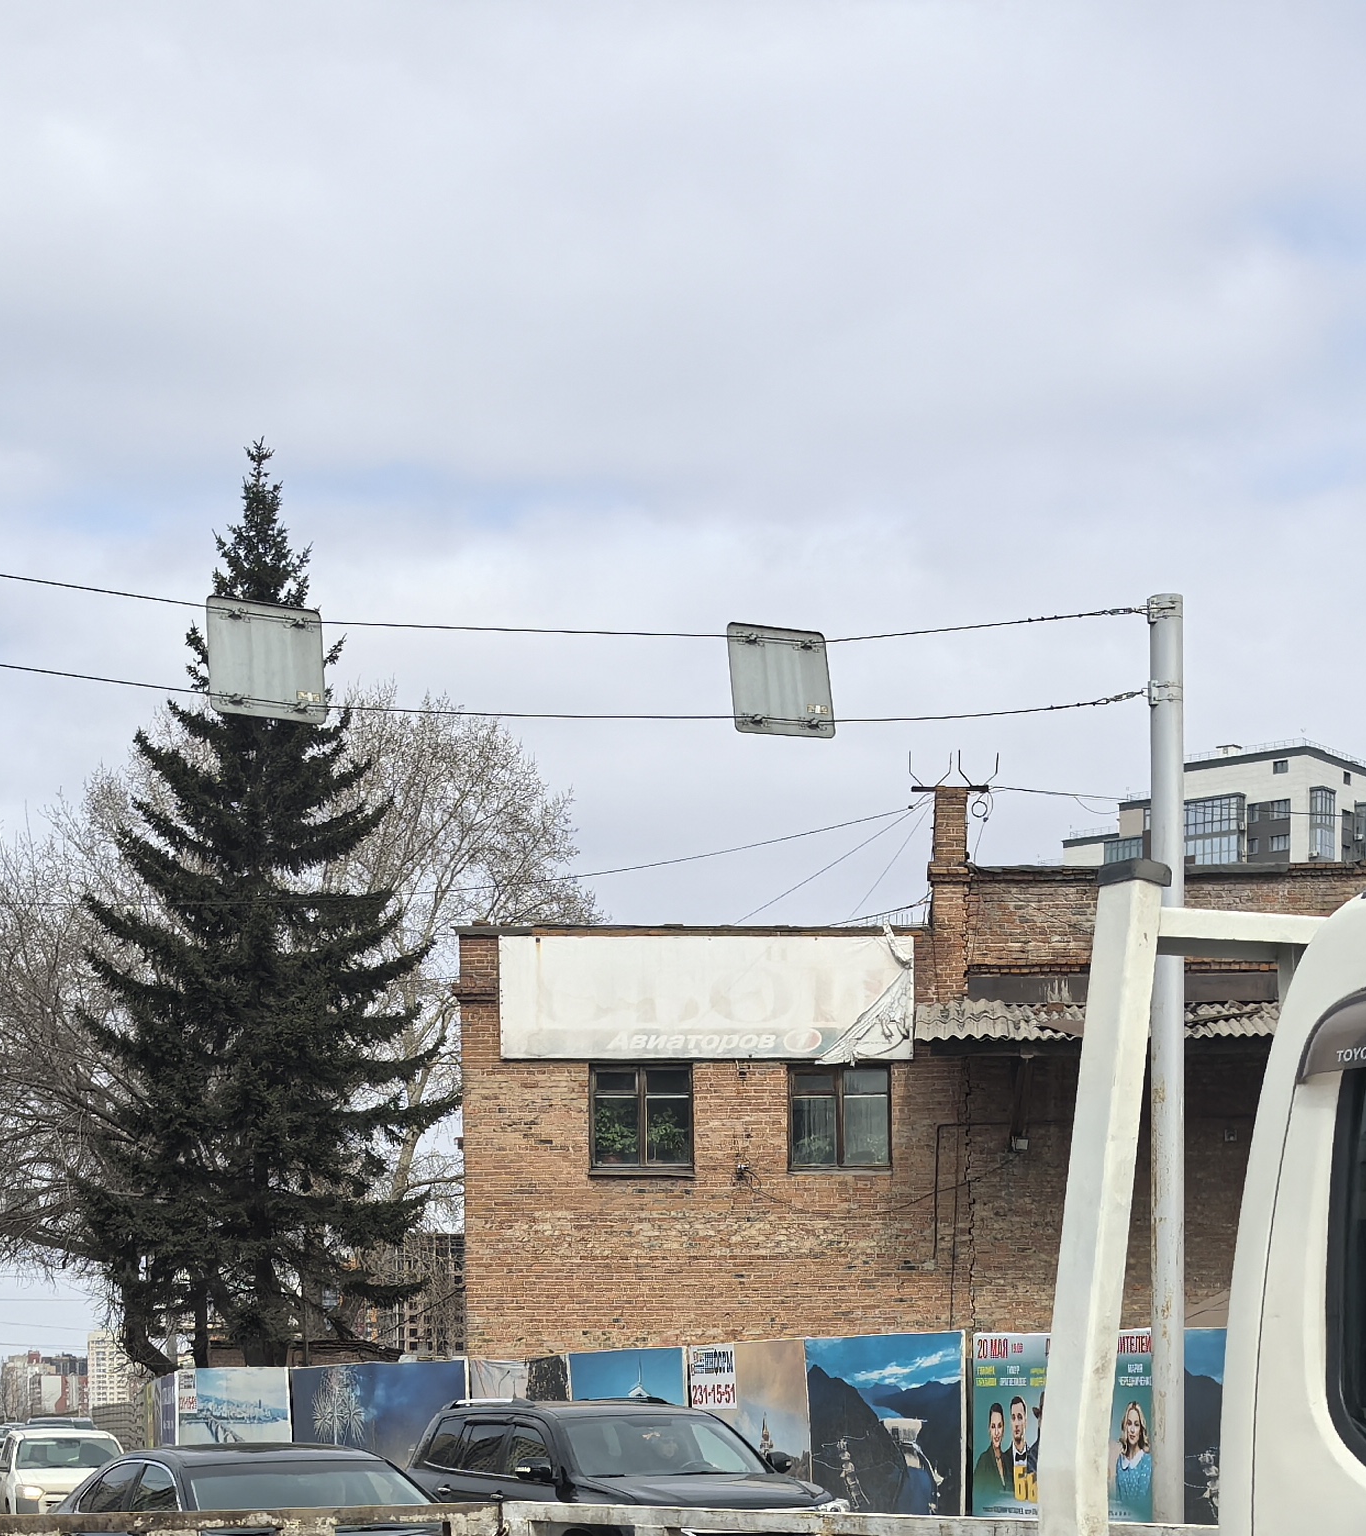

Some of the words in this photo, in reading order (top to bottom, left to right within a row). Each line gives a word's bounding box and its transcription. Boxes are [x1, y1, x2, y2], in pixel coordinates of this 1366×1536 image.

[606, 1031, 777, 1053] Авиаторов
[977, 1338, 988, 1359] 20
[990, 1337, 1008, 1359] МАЯ
[692, 1383, 736, 1405] 231-15-51
